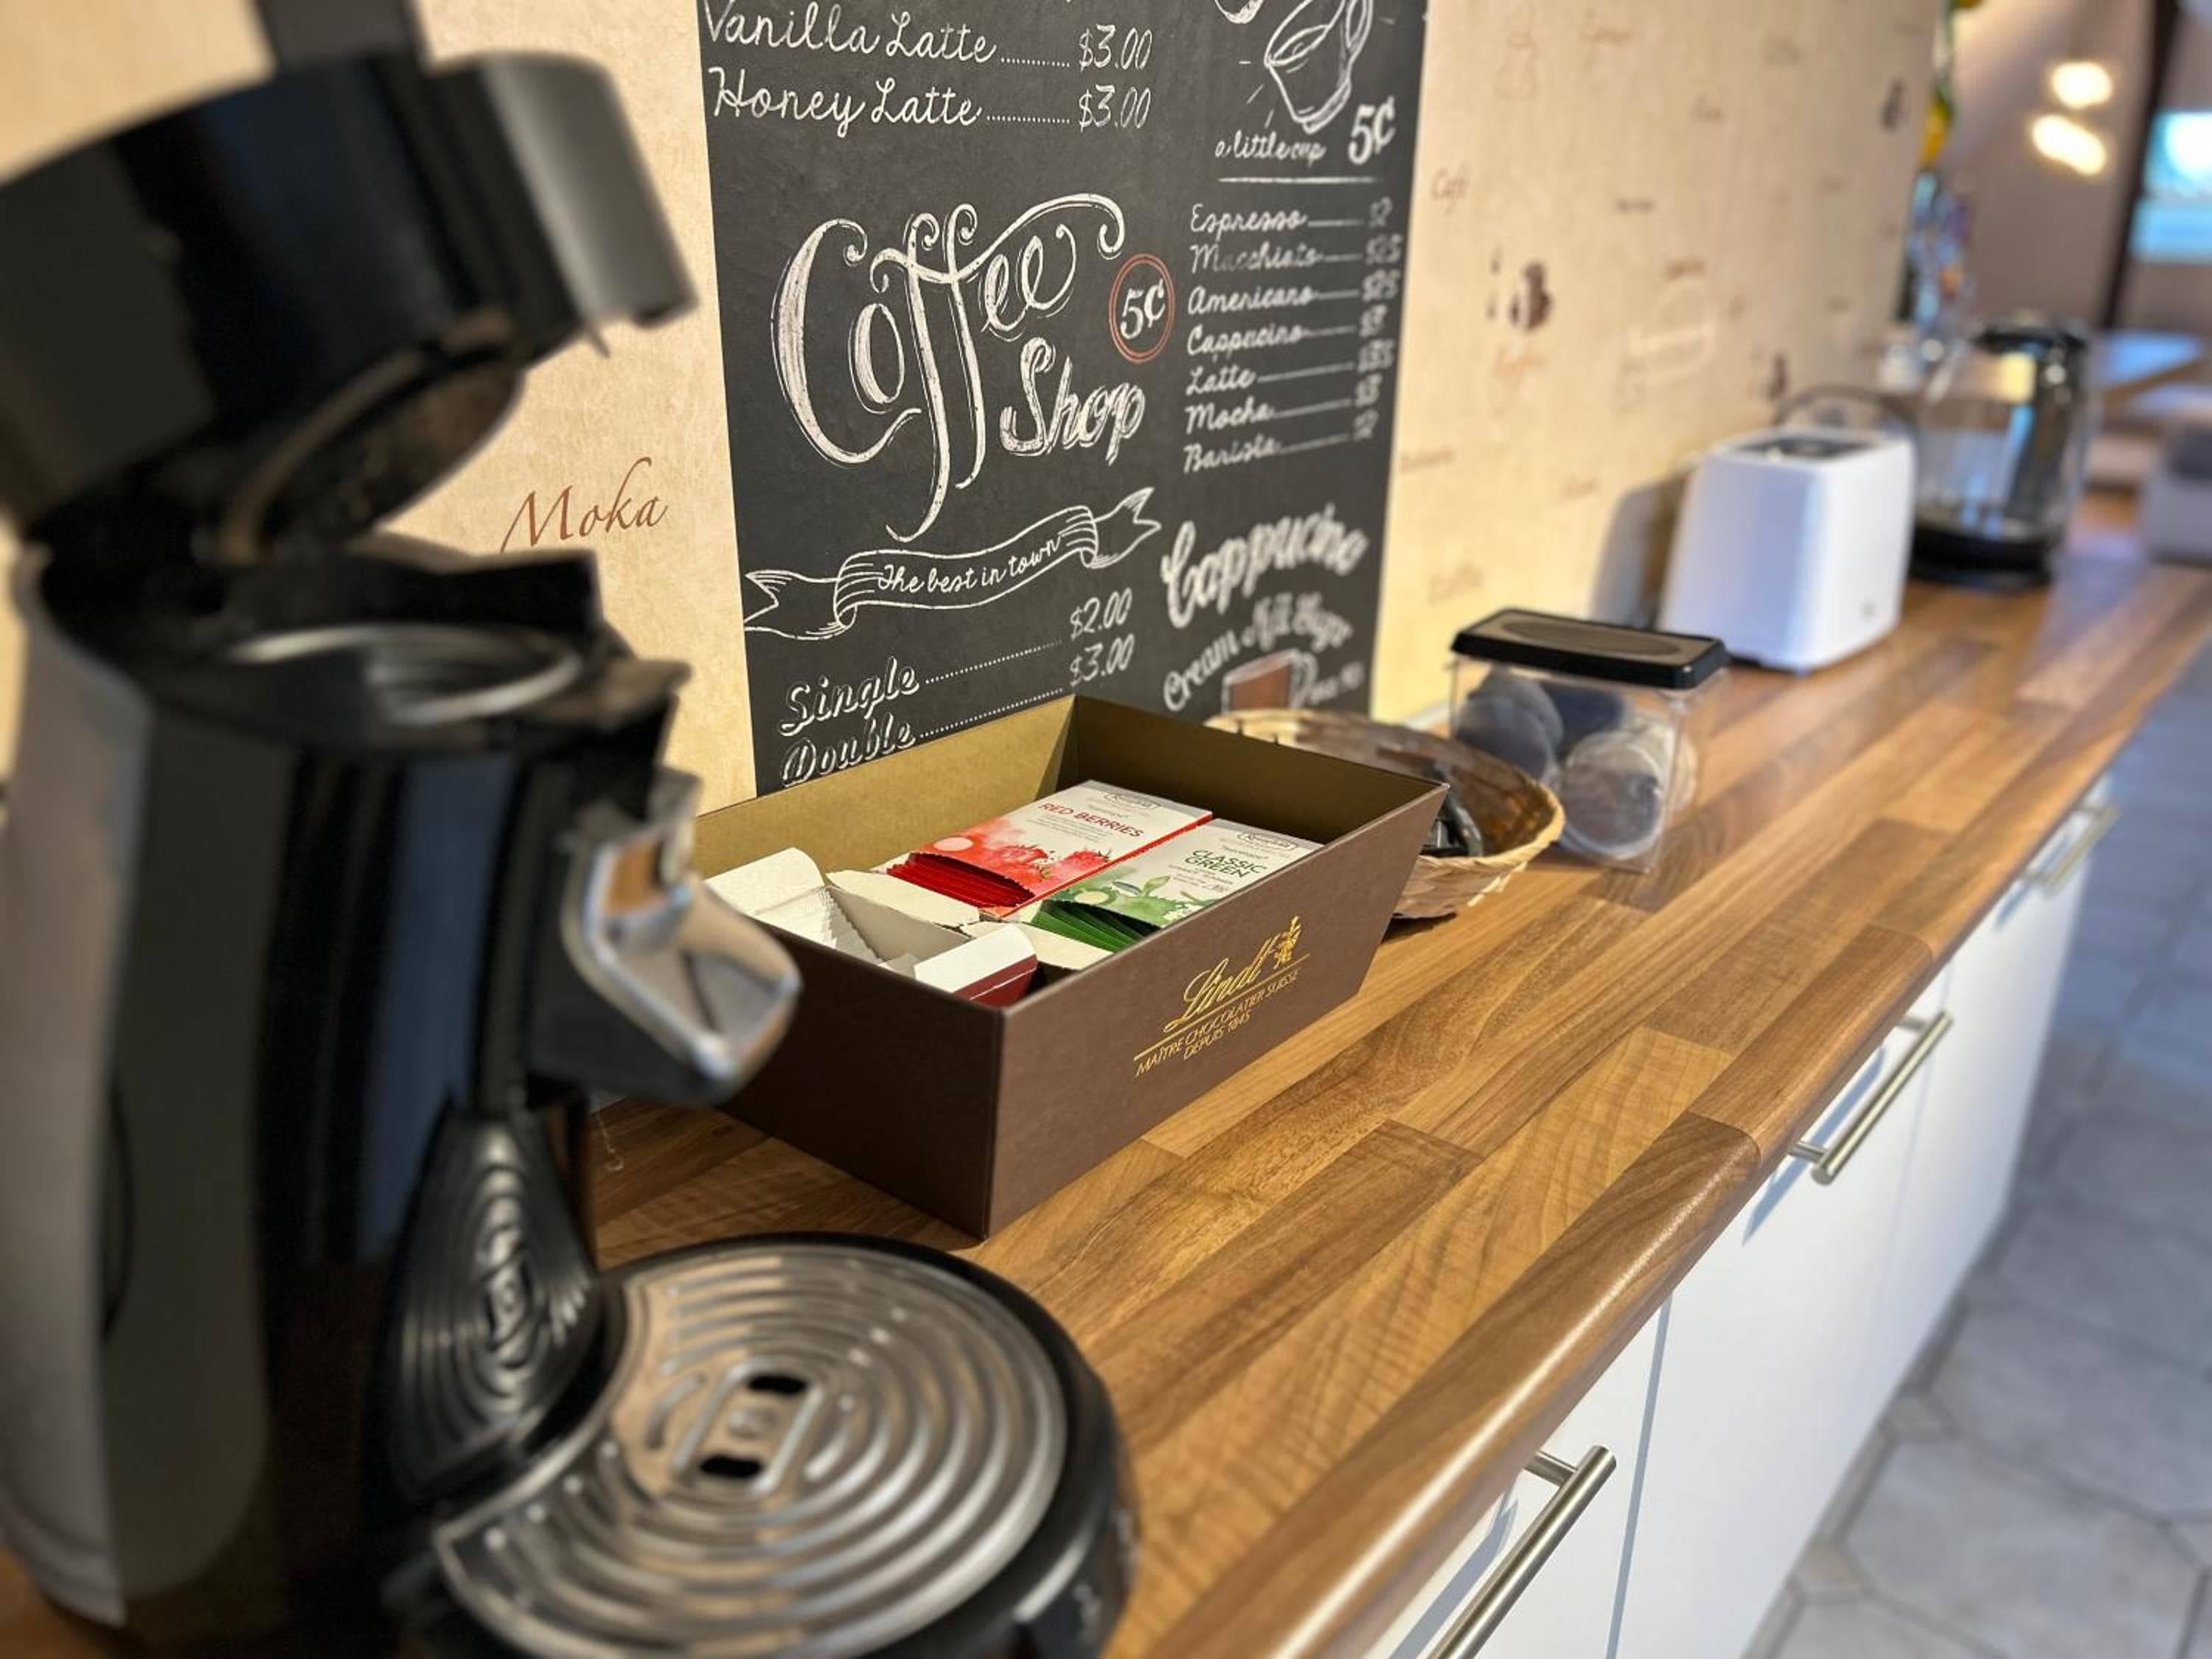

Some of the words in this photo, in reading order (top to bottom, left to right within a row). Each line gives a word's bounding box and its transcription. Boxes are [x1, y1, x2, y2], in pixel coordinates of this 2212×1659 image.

[703, 0, 880, 54] Vanilla
[886, 11, 996, 62] Latte
[1079, 24, 1152, 72] $3.00
[708, 67, 866, 137] Honey
[871, 77, 982, 126] Latte
[1078, 85, 1151, 131] $3.00
[1190, 204, 1308, 240] Espresso
[1188, 285, 1318, 314] Americano
[771, 192, 1124, 542] Coffee
[1186, 365, 1256, 395] Latte
[1000, 337, 1145, 466] Shop
[1185, 396, 1274, 434] Mocha
[1183, 434, 1281, 473] Barista
[500, 456, 669, 554] Moka
[878, 564, 925, 593] The
[928, 567, 978, 593] best
[981, 566, 1007, 586] in
[1008, 537, 1062, 577] town
[778, 656, 920, 737] Single
[1070, 587, 1133, 641] $2.00
[1164, 630, 1239, 712] Cream
[779, 713, 916, 788] Double
[1069, 633, 1135, 686] $3.00
[1038, 803, 1074, 815] RED
[1074, 810, 1144, 838] BERRIES
[1183, 856, 1250, 879] GREEN
[1192, 849, 1267, 874] CLASSIC
[1164, 933, 1281, 1032] Lindt
